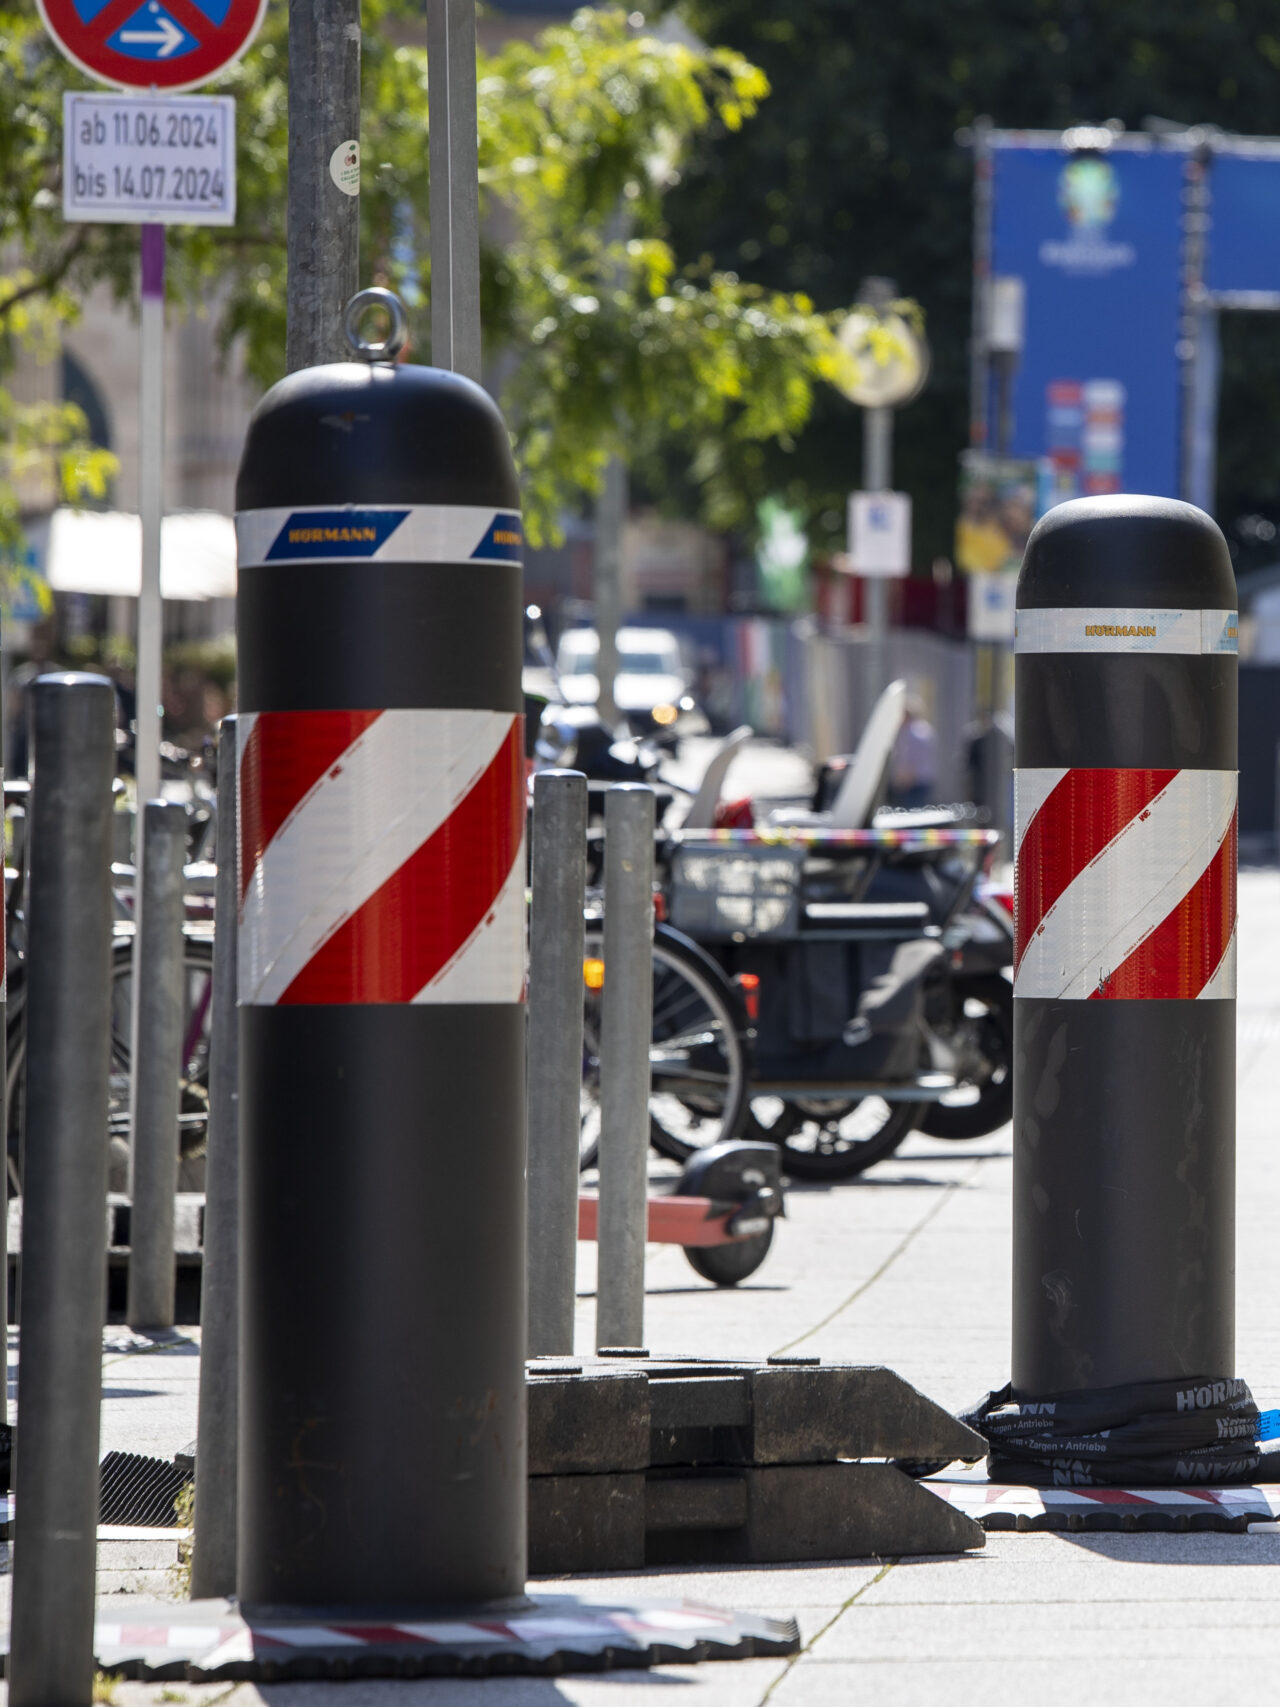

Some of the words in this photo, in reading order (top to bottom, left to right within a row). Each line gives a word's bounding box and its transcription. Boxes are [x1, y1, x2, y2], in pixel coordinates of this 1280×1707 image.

[79, 112, 106, 145] ab
[114, 112, 217, 148] 11.06.2024
[75, 163, 107, 198] bis
[114, 164, 224, 200] 14.07.2024
[1065, 1441, 1107, 1453] Antriebe
